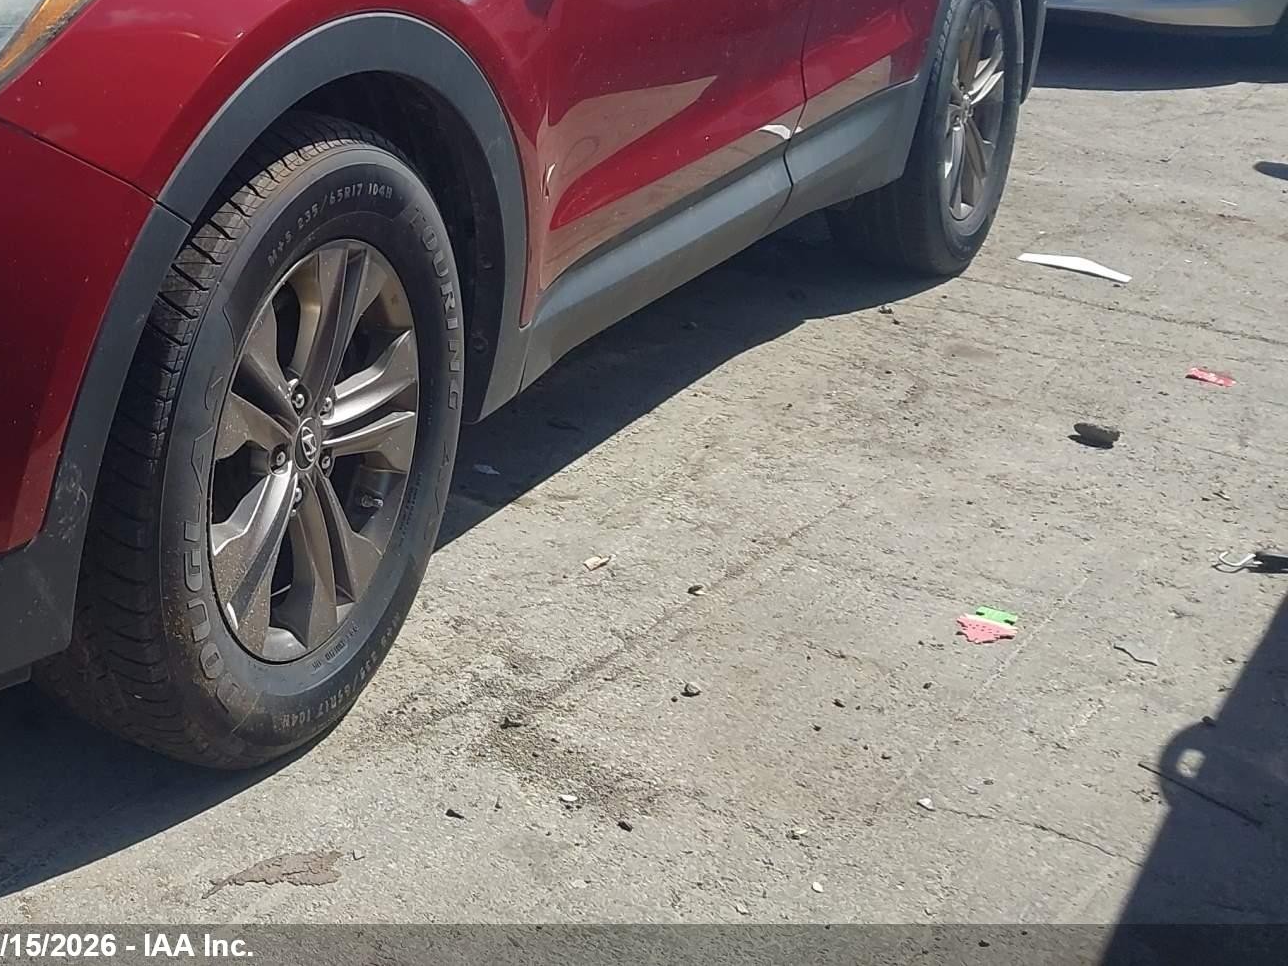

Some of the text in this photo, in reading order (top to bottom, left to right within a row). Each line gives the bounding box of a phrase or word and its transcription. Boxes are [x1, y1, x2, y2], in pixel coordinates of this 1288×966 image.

[267, 182, 394, 267] M+S 235/65R17 104H
[409, 209, 460, 411] TOURING
[183, 369, 242, 714] DOUGLAS
